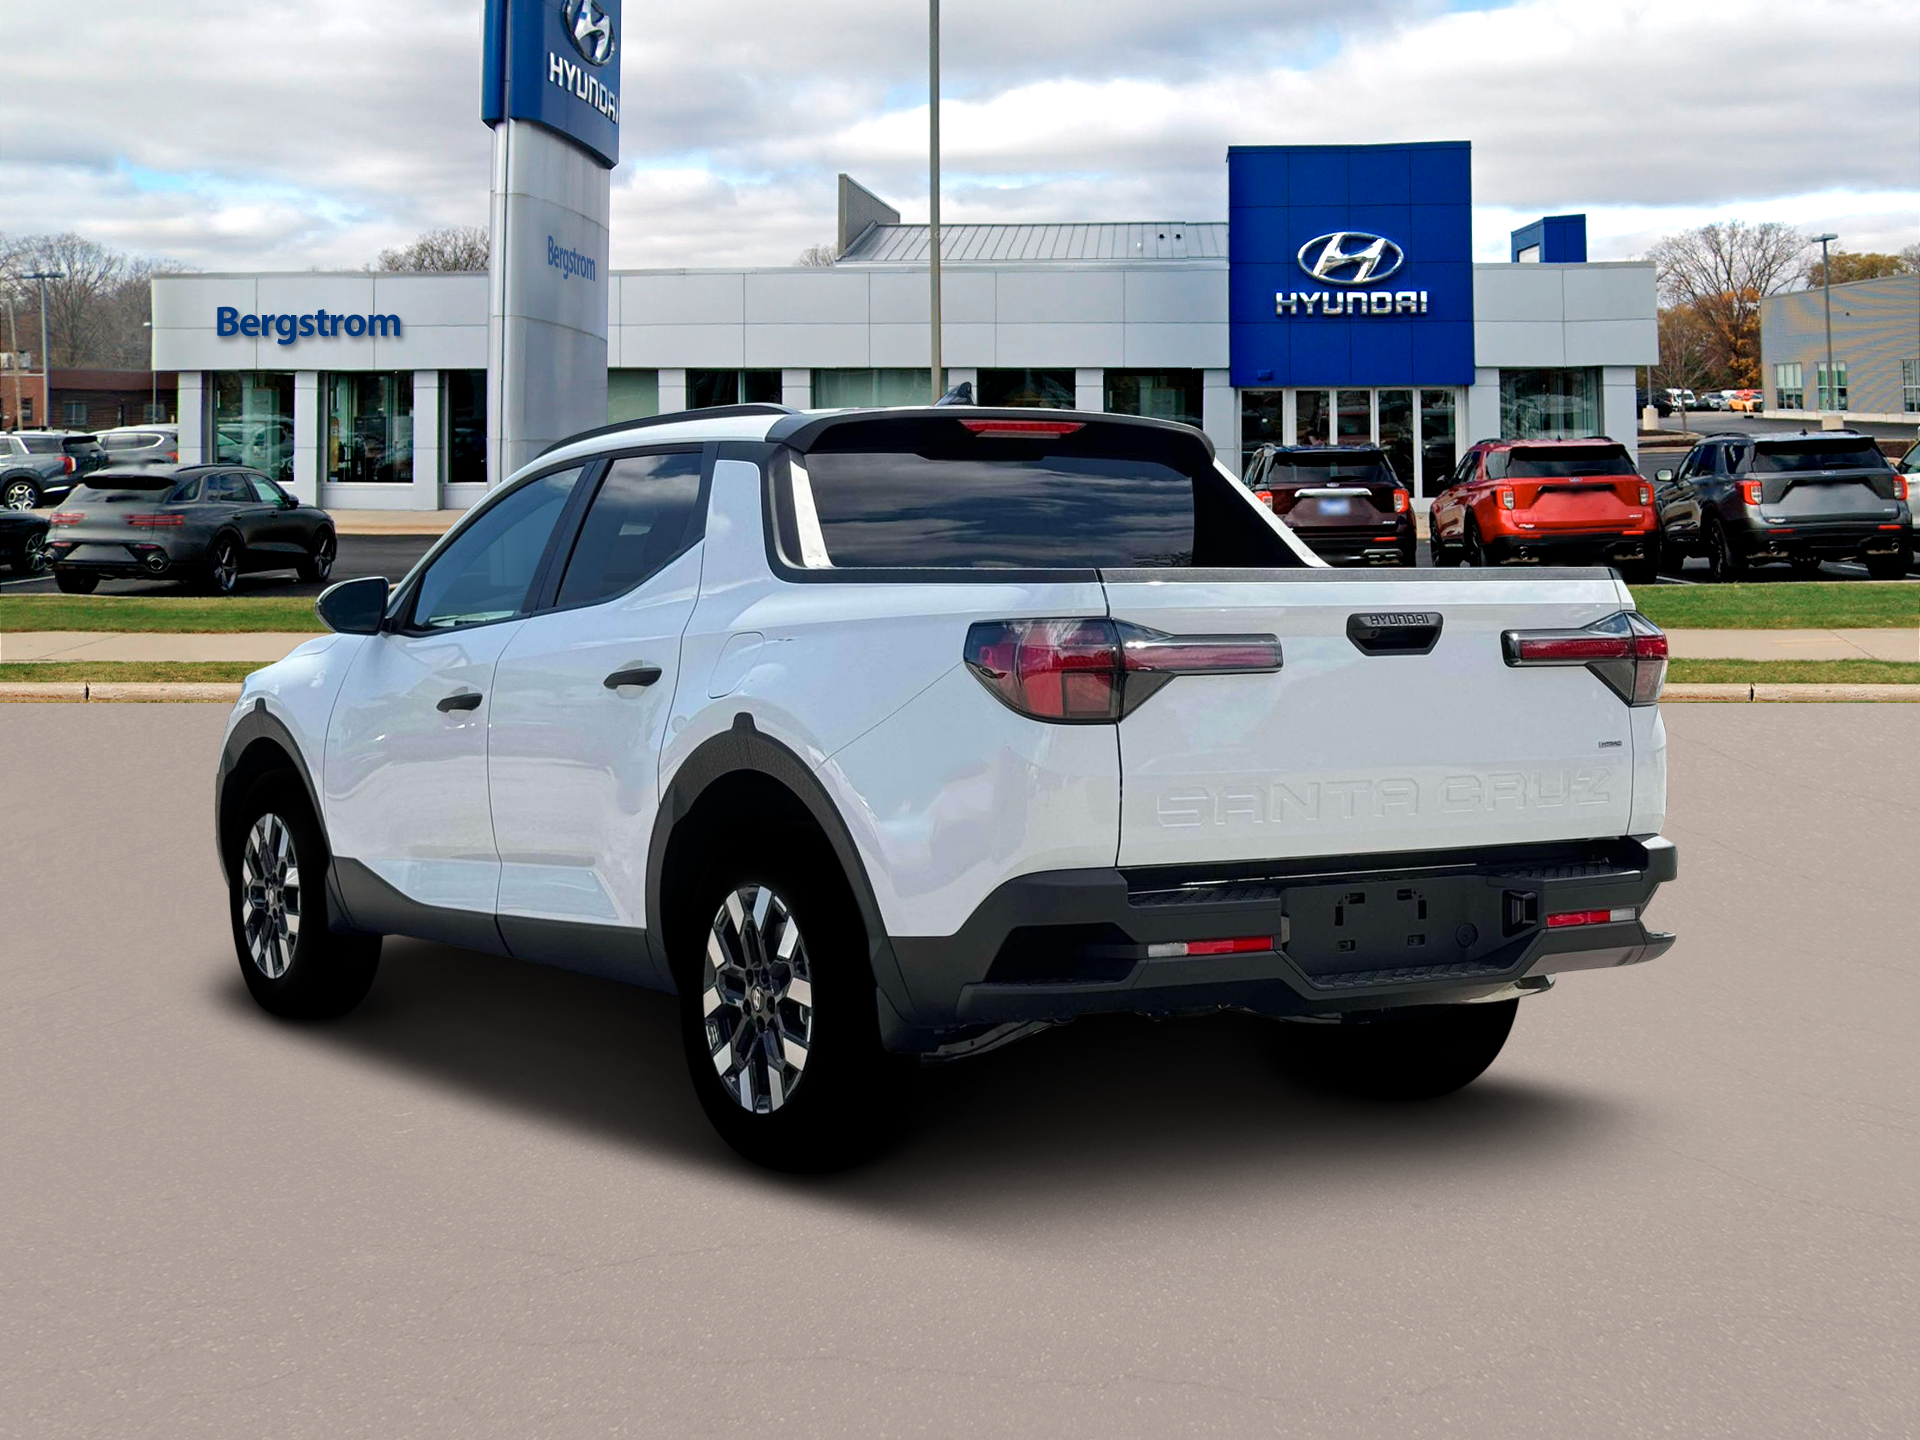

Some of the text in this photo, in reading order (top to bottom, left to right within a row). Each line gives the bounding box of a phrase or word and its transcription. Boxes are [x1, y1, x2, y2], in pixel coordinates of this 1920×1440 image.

[549, 52, 619, 125] HYUNDAI
[548, 235, 596, 282] Bergstrom
[1275, 291, 1429, 315] HYUNDAI
[216, 306, 402, 346] Bergstrom
[1370, 614, 1430, 625] HYUNDAI
[1157, 768, 1613, 827] SANTA CRUZ
